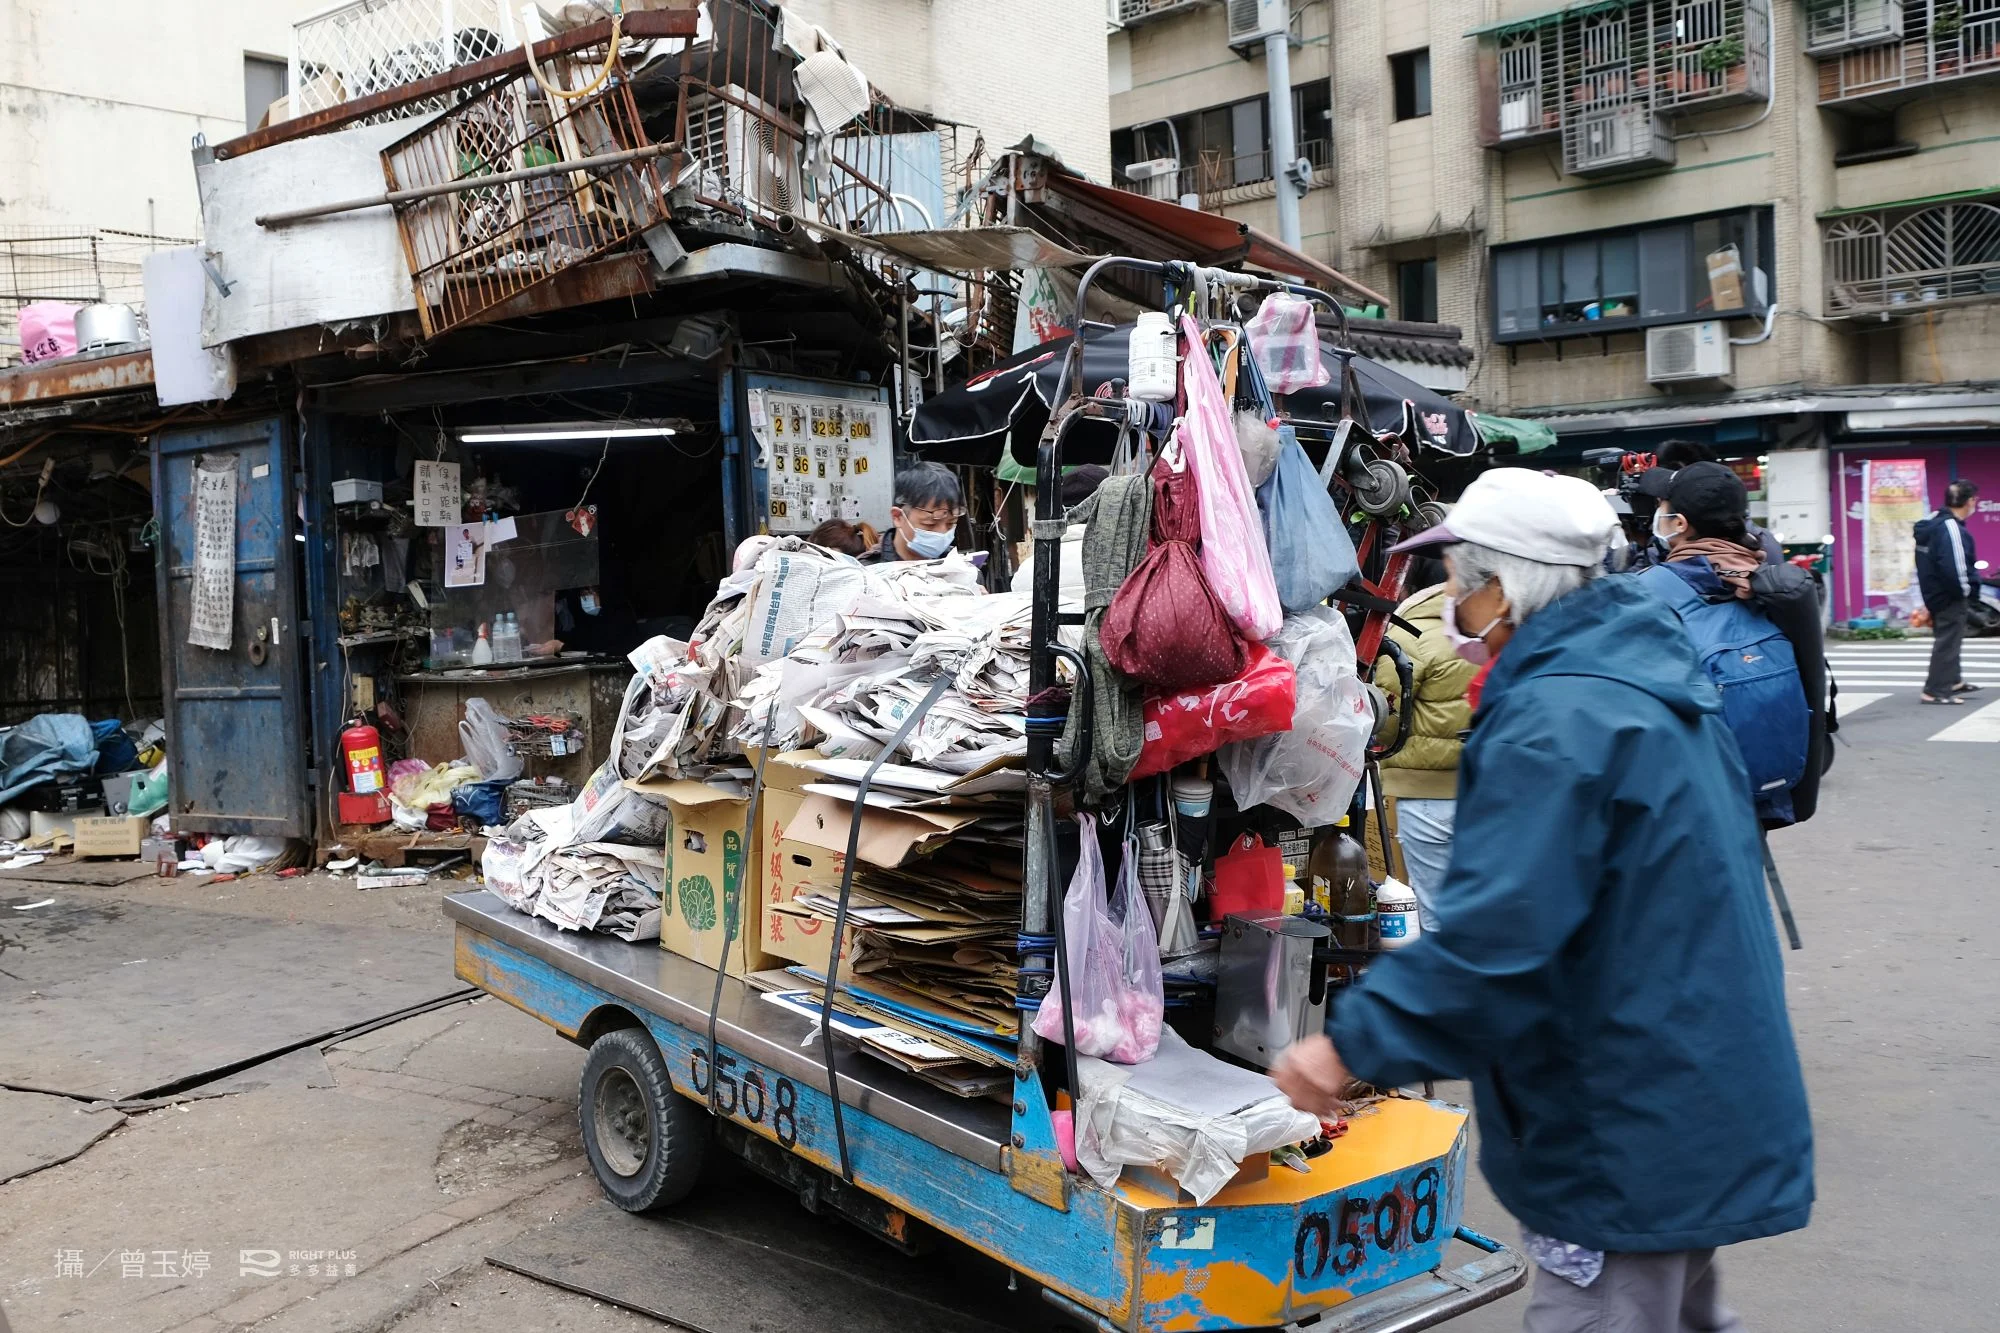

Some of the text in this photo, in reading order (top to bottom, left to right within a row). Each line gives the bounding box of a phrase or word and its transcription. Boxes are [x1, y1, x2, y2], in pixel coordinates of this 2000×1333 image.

[775, 418, 783, 432] 2
[793, 418, 800, 431] 3
[812, 420, 826, 435] 32
[828, 421, 842, 435] 35
[850, 422, 870, 437] 600
[777, 456, 784, 469] 3
[794, 458, 808, 472] 36
[818, 463, 825, 476] 9
[840, 458, 846, 472] 6
[855, 457, 868, 472] 10
[771, 501, 786, 515] 60
[769, 820, 786, 943] 分級包裝
[691, 1047, 797, 1150] 0508
[1295, 1166, 1440, 1280] 0508
